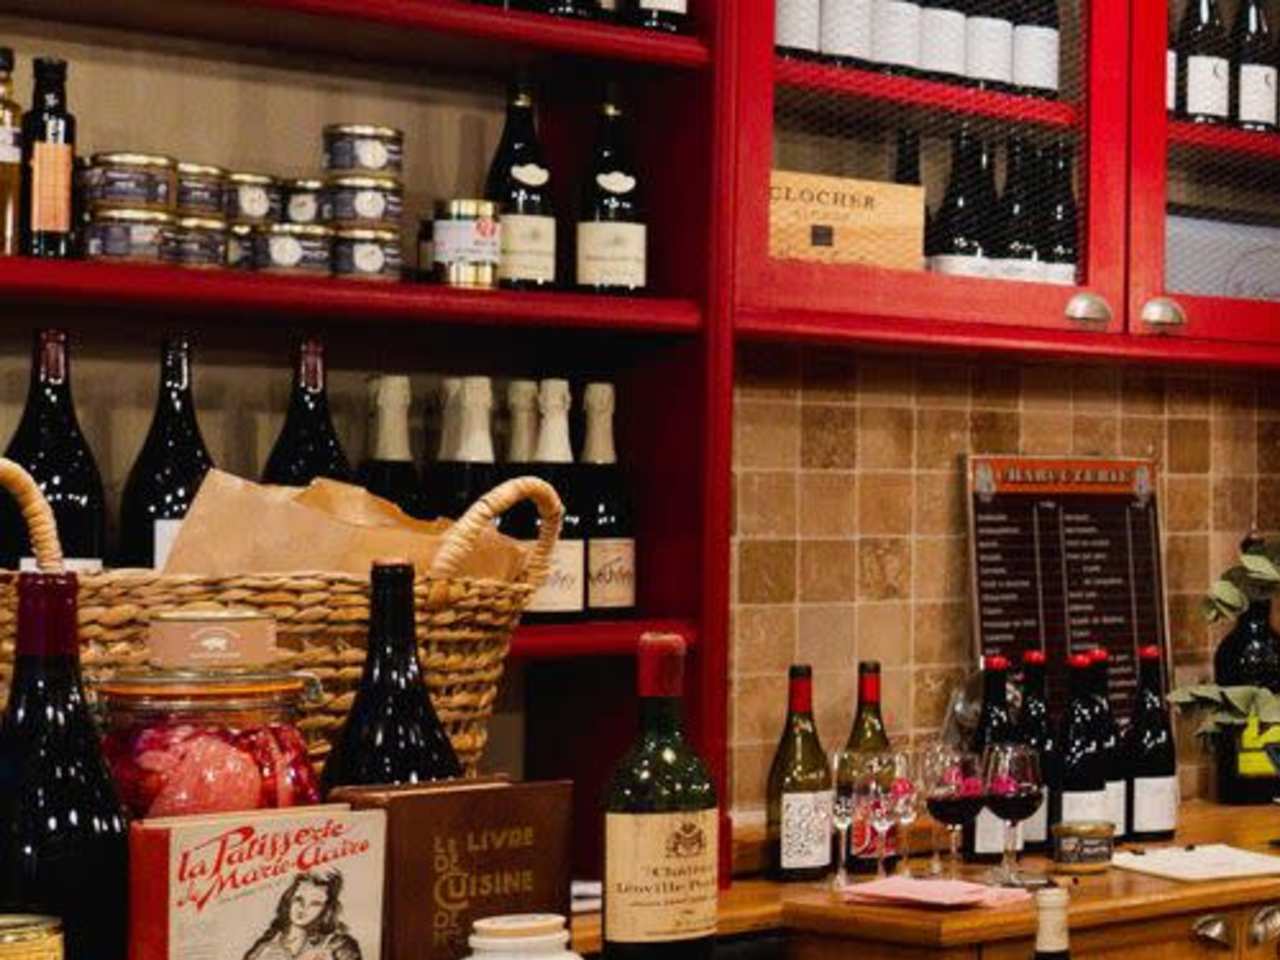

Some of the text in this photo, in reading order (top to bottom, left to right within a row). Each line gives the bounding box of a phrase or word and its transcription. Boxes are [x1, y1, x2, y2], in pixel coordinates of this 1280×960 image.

[768, 186, 876, 209] CLOCHER
[467, 826, 534, 850] LIVRE
[433, 864, 535, 911] CUISINE
